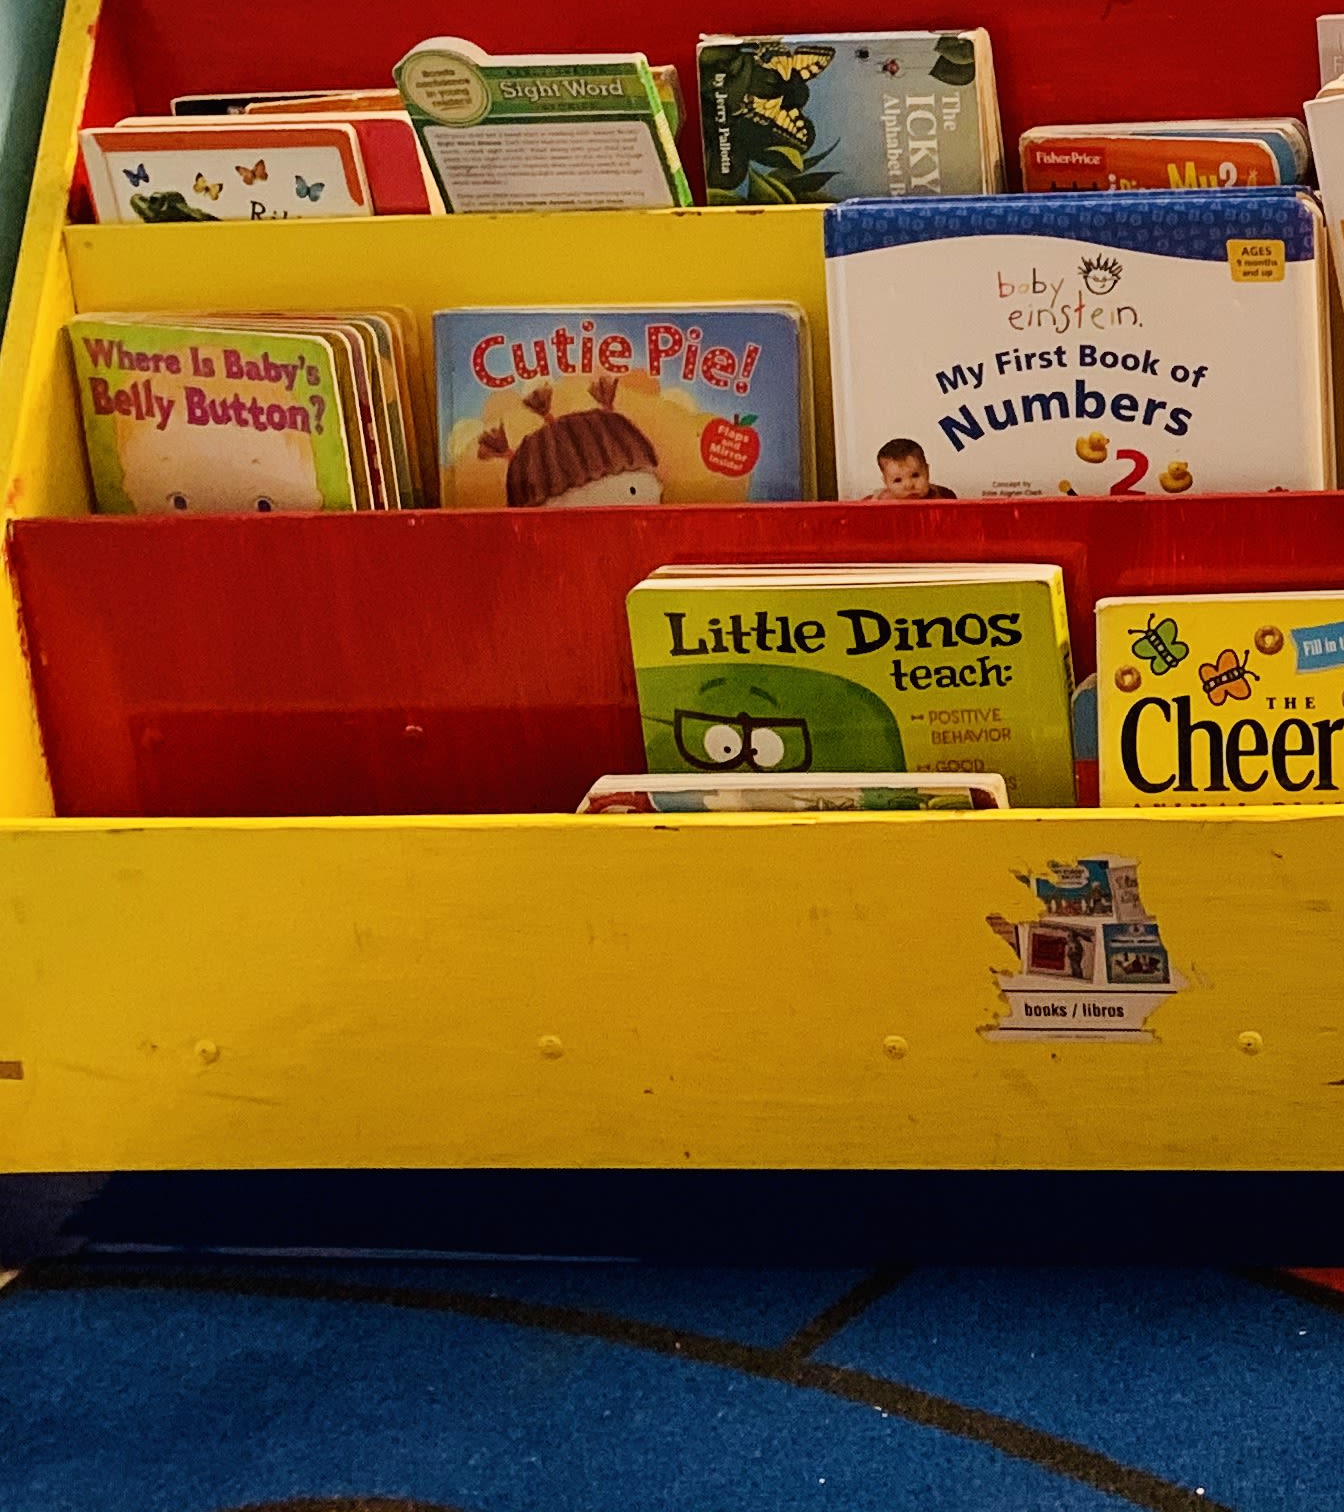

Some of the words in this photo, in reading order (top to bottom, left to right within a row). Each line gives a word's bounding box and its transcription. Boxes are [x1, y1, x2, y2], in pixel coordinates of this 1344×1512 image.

[499, 80, 560, 102] Sight
[564, 79, 625, 97] Word
[713, 72, 727, 88] by
[714, 90, 729, 124] Jerry
[941, 91, 961, 132] The
[718, 127, 731, 175] Pallotta
[881, 93, 903, 178] Alphabet
[904, 92, 941, 195] ICKY
[1241, 246, 1273, 256] AGES
[997, 267, 1065, 309] baby
[82, 336, 183, 375] Where
[189, 346, 217, 379] Is
[222, 348, 322, 392] Baby's
[471, 319, 634, 389] Cutie
[646, 322, 762, 396] Pie!
[935, 361, 985, 395] My
[995, 344, 1069, 376] First
[1077, 343, 1161, 377] Book
[1169, 363, 1210, 389] of
[88, 375, 176, 432] Belly
[184, 385, 327, 437] Button?
[937, 378, 1194, 453] Numbers
[1110, 448, 1150, 496] 2
[663, 610, 827, 657] Little
[836, 608, 1023, 656] Dinos
[1302, 639, 1324, 658] Fill
[1325, 636, 1338, 654] in
[889, 656, 1014, 692] teach:
[927, 707, 1002, 726] POSITIVE
[1265, 696, 1317, 711] THE
[931, 727, 1012, 745] BEHAVIOR
[935, 758, 986, 774] GOOD
[1023, 1002, 1068, 1019] books
[1081, 1002, 1126, 1019] libros
